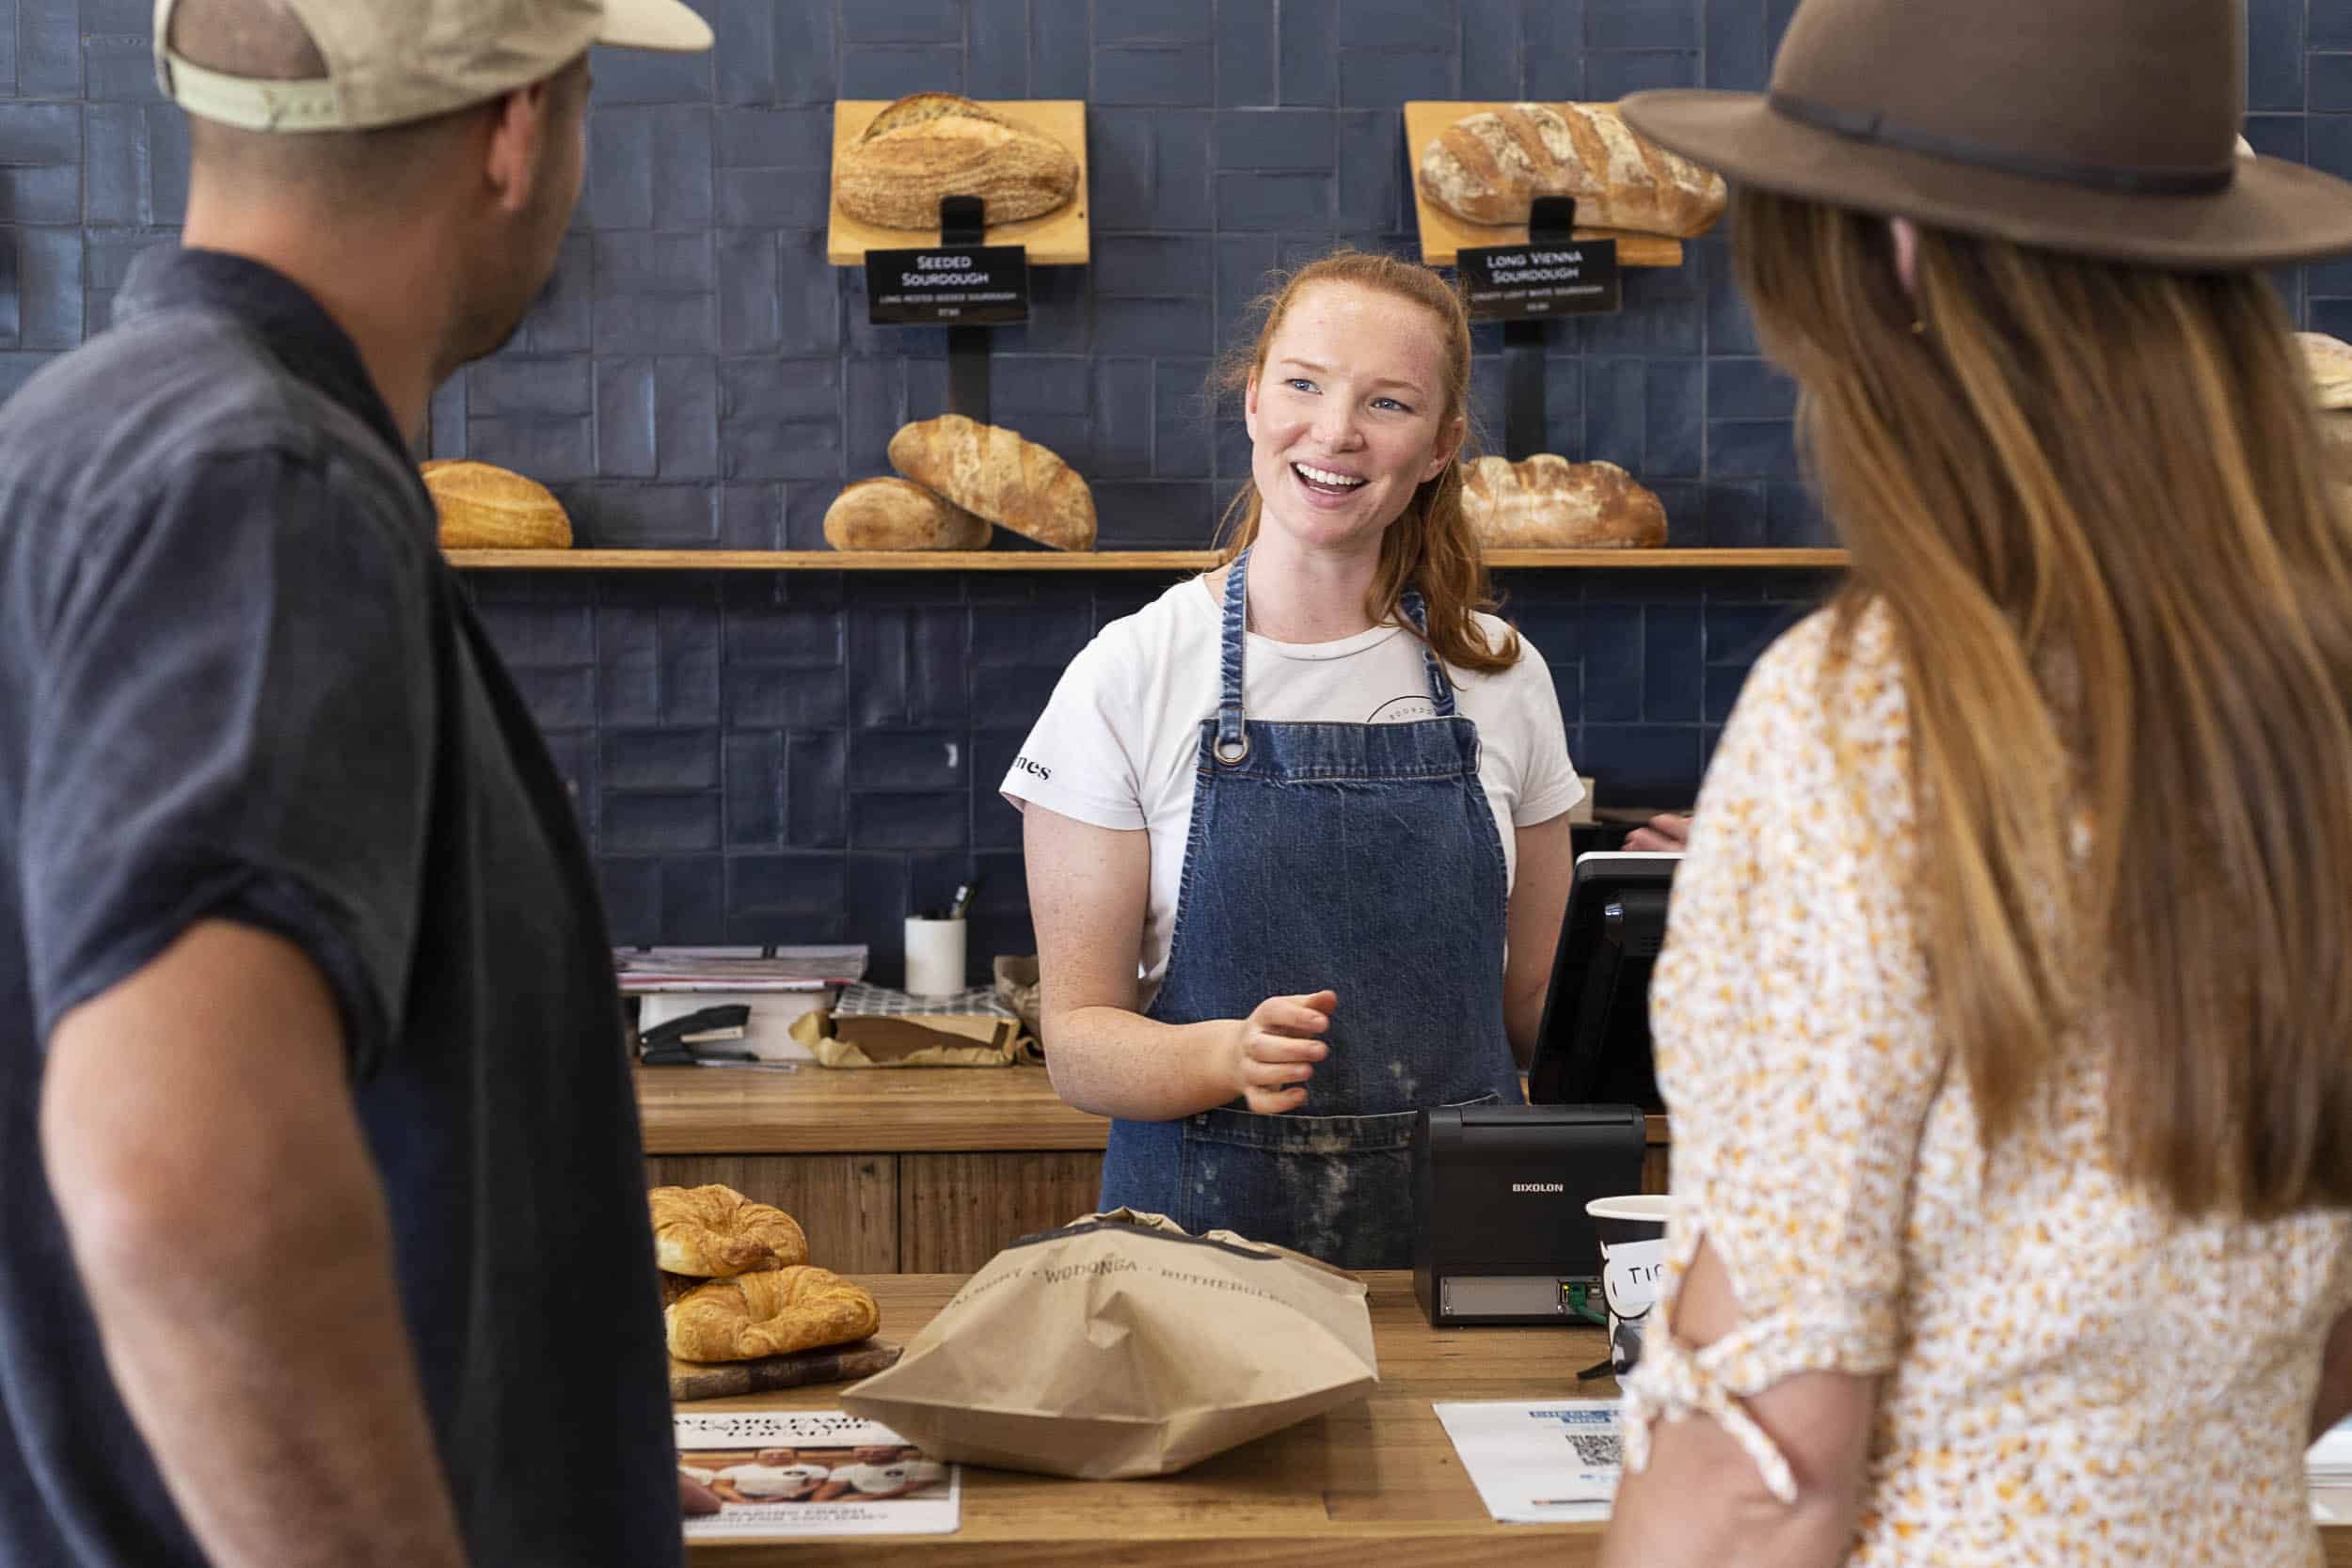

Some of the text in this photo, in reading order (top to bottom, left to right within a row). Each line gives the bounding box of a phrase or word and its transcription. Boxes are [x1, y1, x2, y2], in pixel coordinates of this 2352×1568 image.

[916, 255, 972, 270] SEEDED
[1486, 250, 1583, 269] LONG VIENNA
[901, 272, 990, 287] SOURDOUGH
[1492, 267, 1580, 284] SOURDOUGH
[1015, 756, 1052, 781] nes
[1512, 1182, 1565, 1193] BIXOLON
[1045, 1253, 1138, 1285] WODONGA
